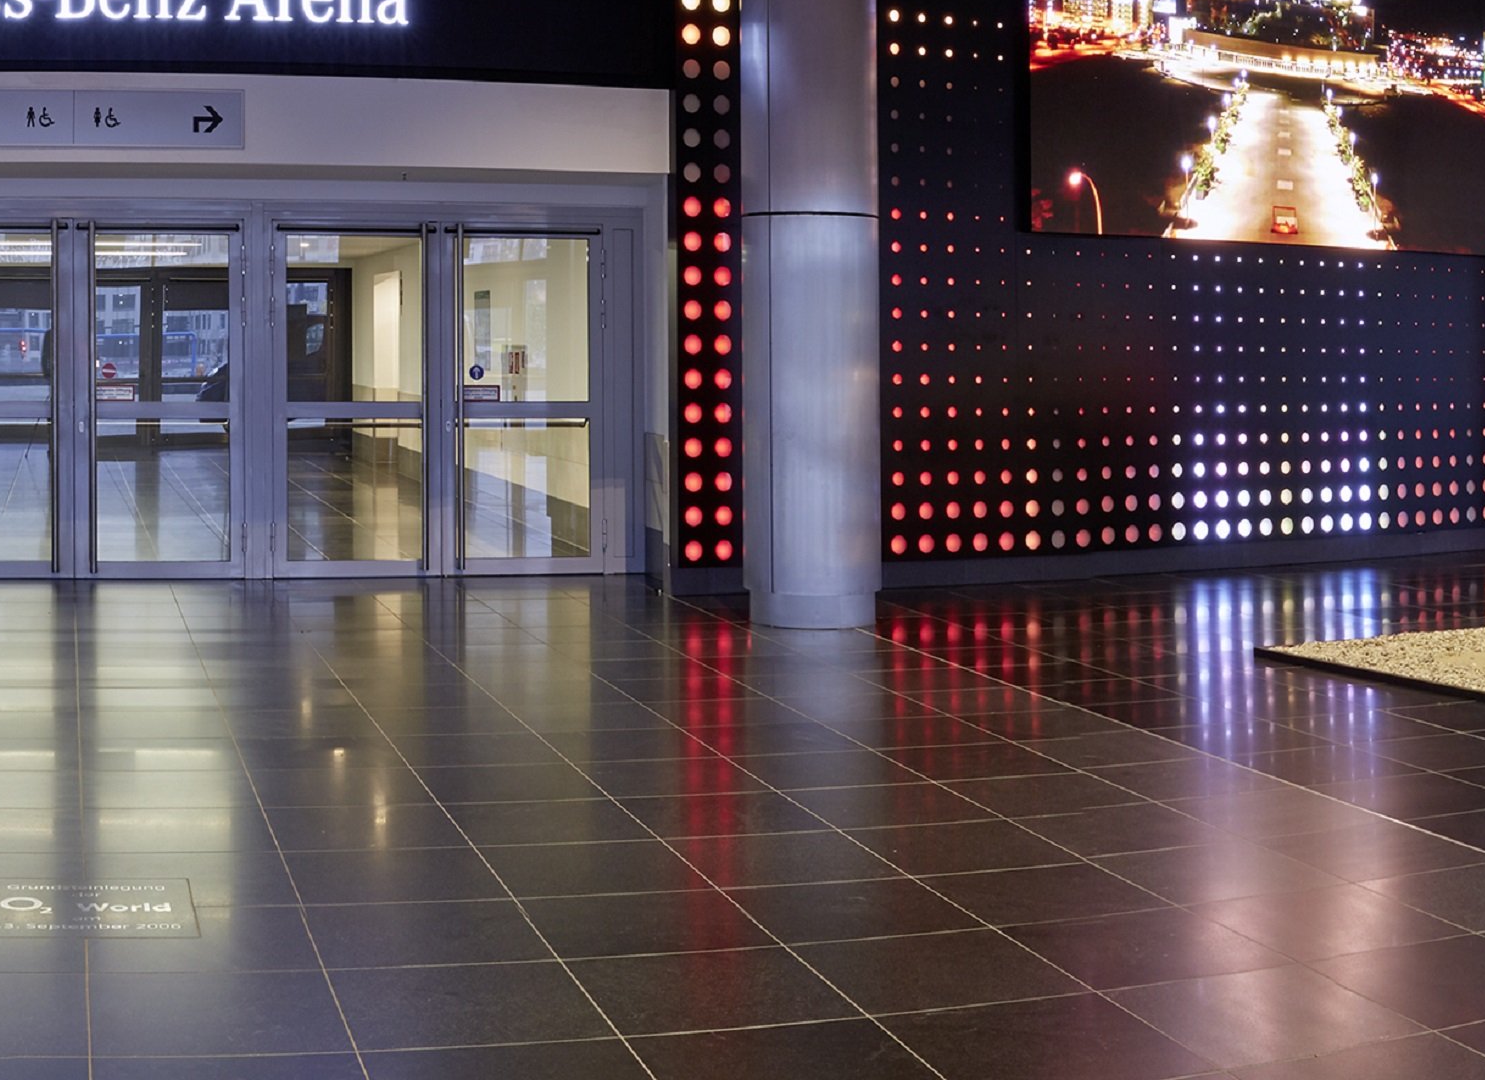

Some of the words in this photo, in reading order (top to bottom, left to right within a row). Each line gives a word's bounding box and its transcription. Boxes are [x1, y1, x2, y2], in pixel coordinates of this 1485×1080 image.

[76, 902, 172, 913] World
[25, 922, 130, 931] September
[135, 922, 182, 930] 2006
